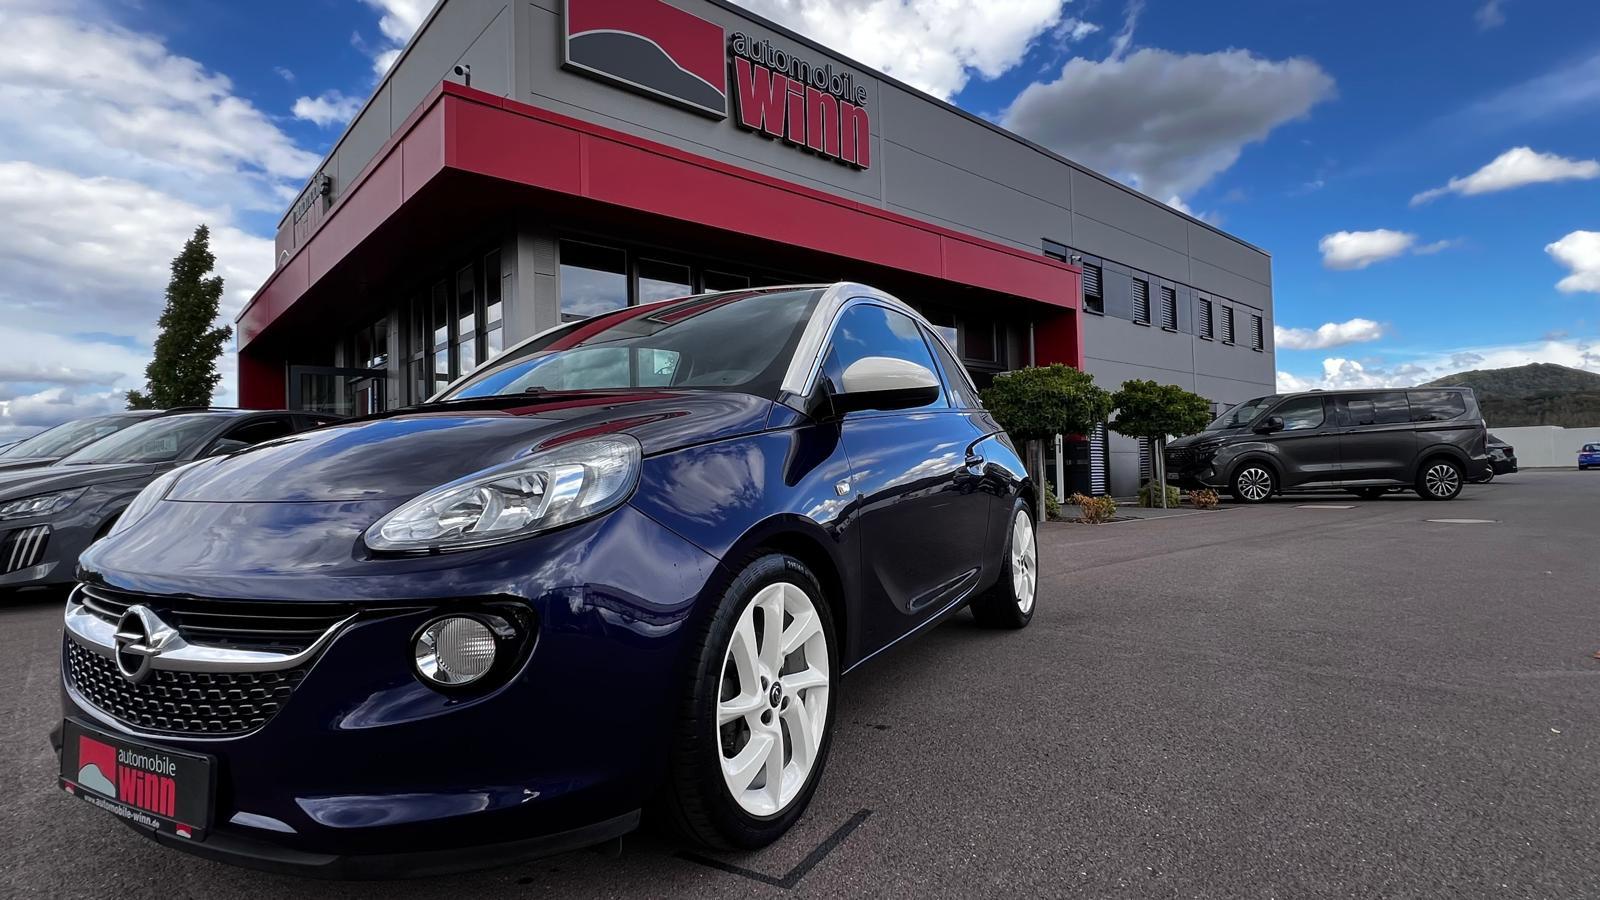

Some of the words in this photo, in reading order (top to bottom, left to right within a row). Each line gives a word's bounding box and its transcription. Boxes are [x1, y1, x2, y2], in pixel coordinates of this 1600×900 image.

[733, 31, 868, 105] automobile
[734, 56, 870, 169] winn
[118, 749, 176, 776] automobile
[119, 765, 176, 817] winn
